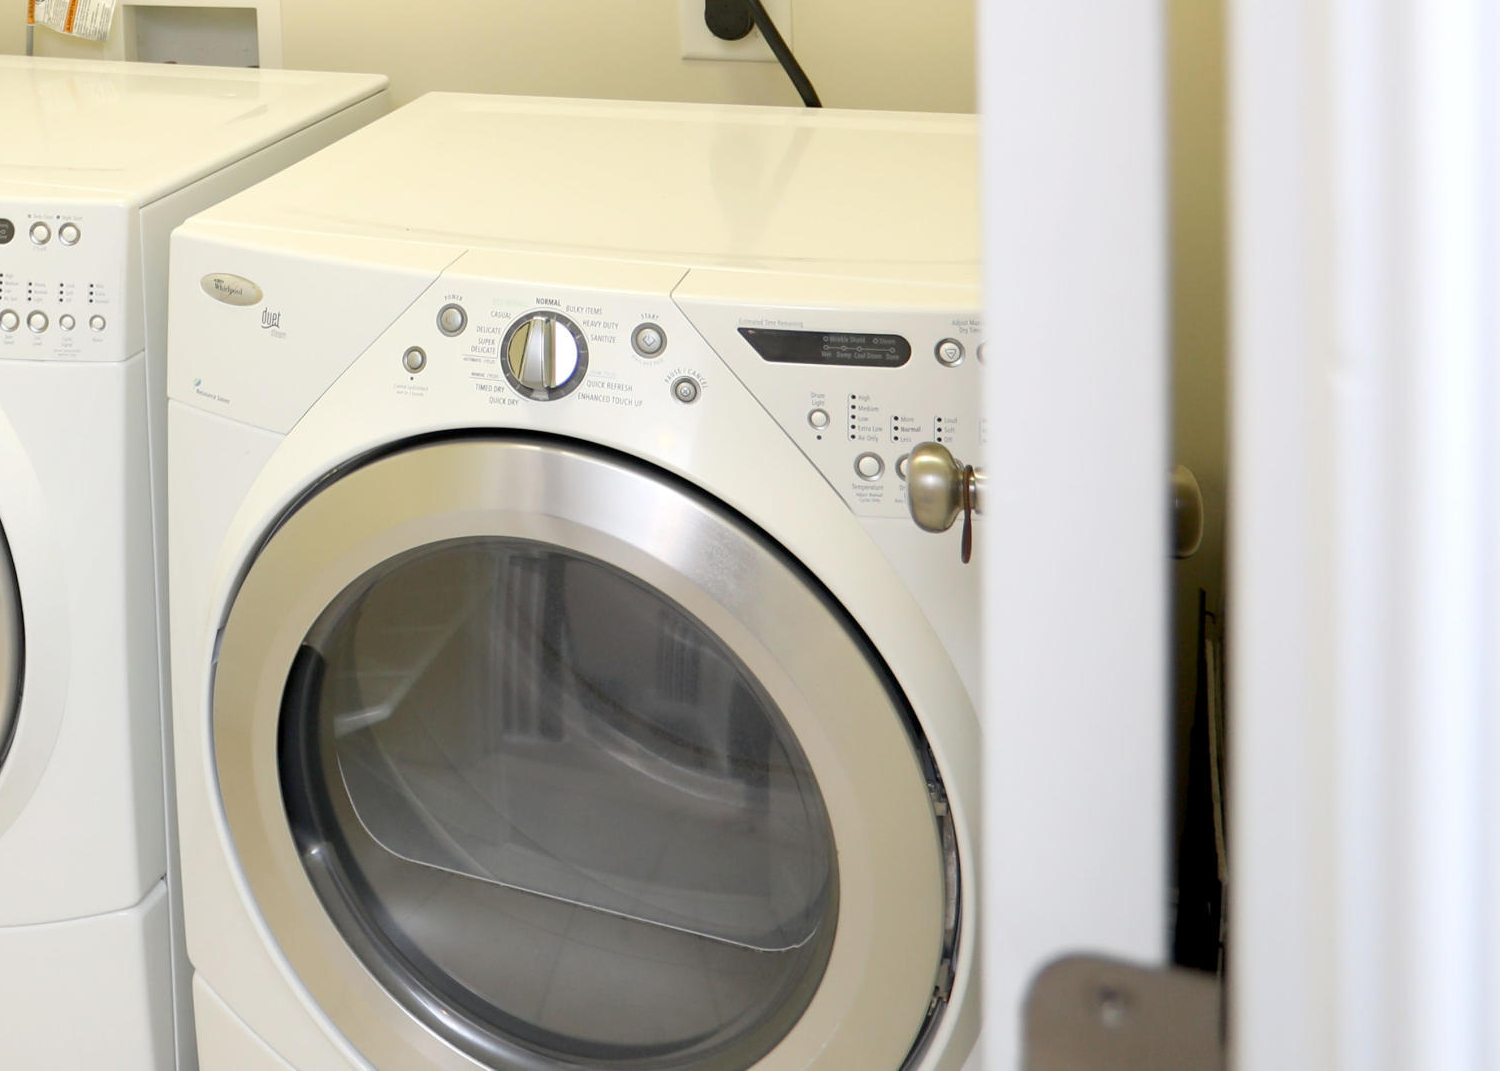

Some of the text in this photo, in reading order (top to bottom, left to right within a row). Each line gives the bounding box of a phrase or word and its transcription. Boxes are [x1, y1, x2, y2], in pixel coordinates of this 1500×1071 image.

[536, 298, 561, 306] NORMAL
[565, 305, 603, 315] BULKY ITEMS
[261, 307, 281, 329] duet
[490, 311, 511, 319] CASUAL
[583, 320, 619, 330] HEAVY DUTY
[476, 326, 501, 334] DELICATE
[478, 338, 495, 346] SUPER
[590, 334, 617, 343] SANITIZE
[471, 345, 496, 354] DELICATE
[475, 384, 505, 393] TIMED DRY
[586, 379, 633, 392] QUICK REFRESH
[489, 397, 519, 407] QUICK DRY
[578, 392, 643, 407] ENHANCED TOUCH UP
